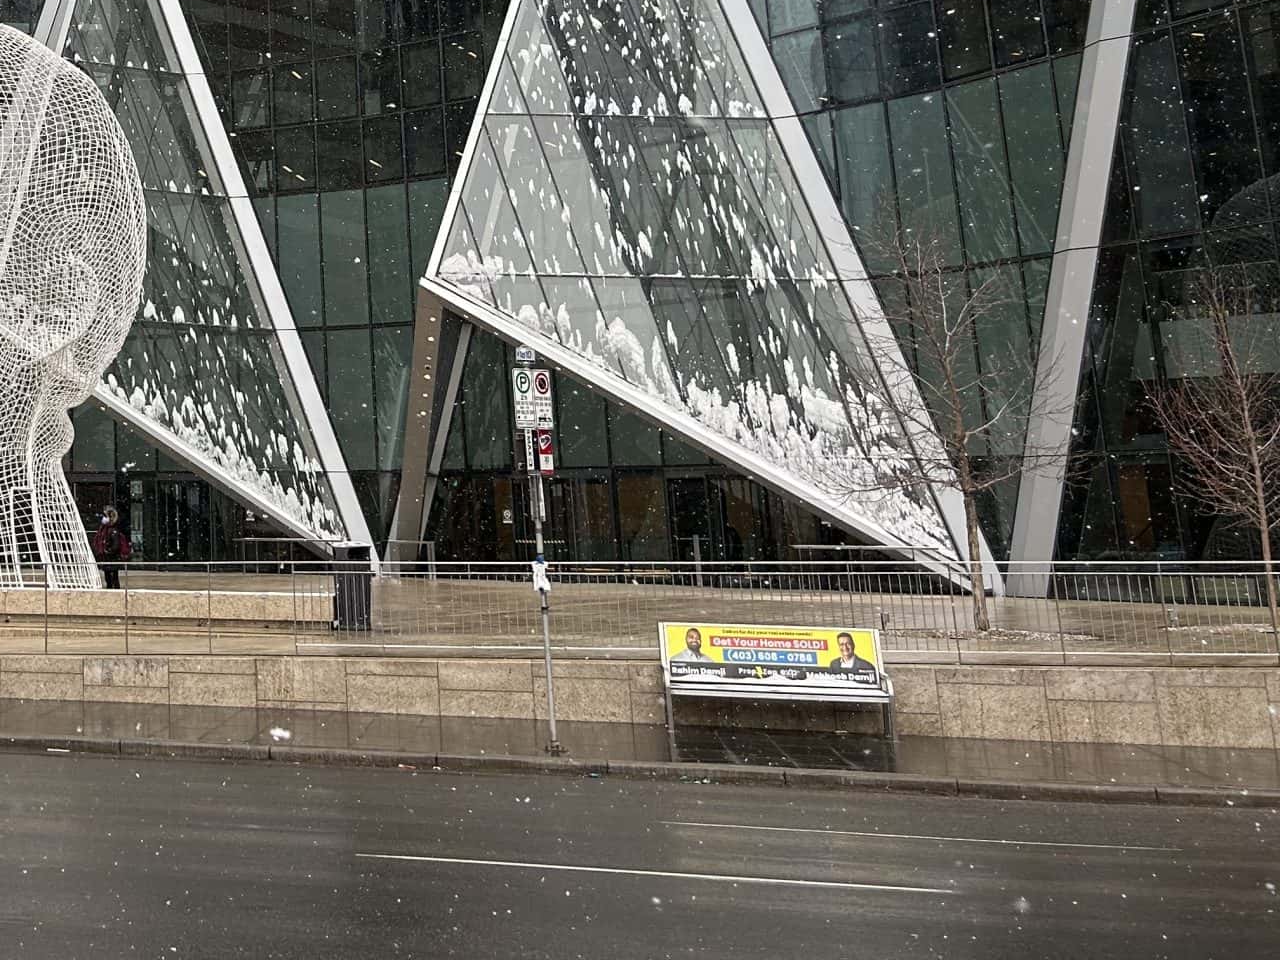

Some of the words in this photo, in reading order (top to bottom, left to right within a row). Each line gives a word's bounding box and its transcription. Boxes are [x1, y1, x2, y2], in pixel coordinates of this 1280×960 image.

[713, 637, 732, 646] Get
[733, 638, 758, 647] Your
[760, 639, 791, 648] Home
[792, 640, 824, 649] SOLD!
[727, 650, 756, 661] (403)
[671, 666, 700, 675] Rahim
[701, 667, 726, 678] Damji
